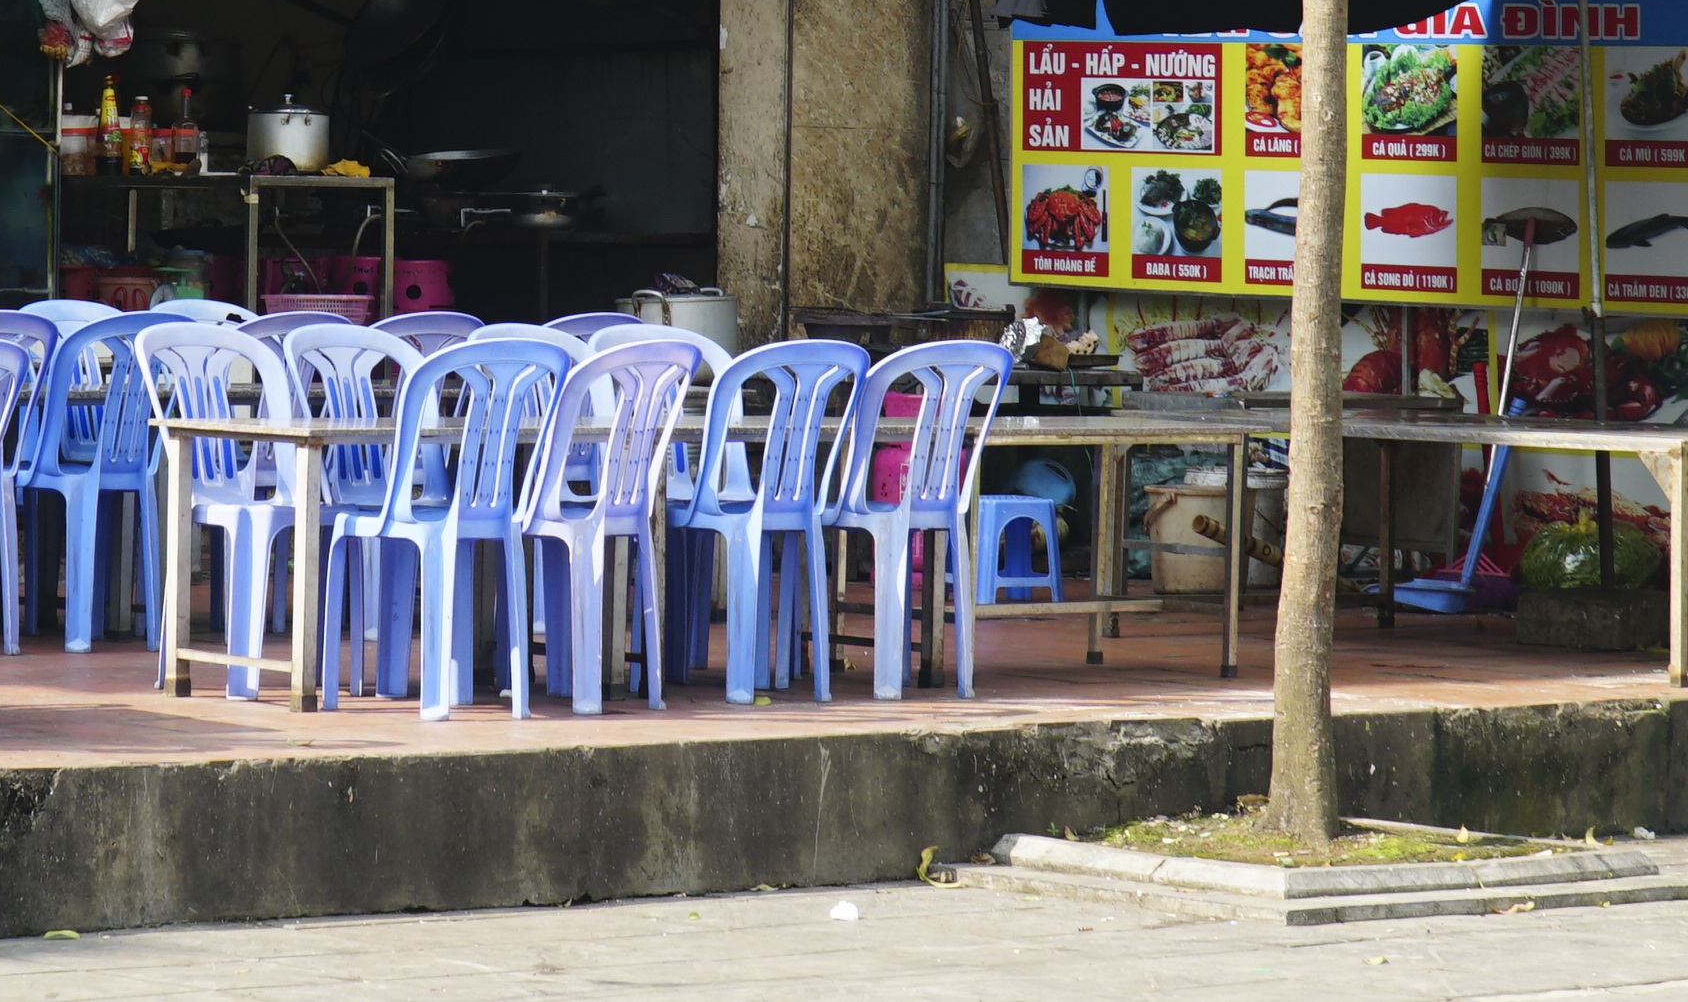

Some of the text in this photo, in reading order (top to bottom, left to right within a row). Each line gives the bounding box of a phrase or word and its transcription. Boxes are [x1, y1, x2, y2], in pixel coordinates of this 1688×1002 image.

[1029, 43, 1216, 78] LẨU HẤP NƯỚNG
[1029, 81, 1061, 111] HẢI
[1028, 117, 1069, 148] SẢN
[1253, 135, 1292, 153] CÁ LĂNG
[1372, 139, 1439, 157] CÁ QUẢ 299K
[1485, 142, 1496, 157] CÁ
[1498, 142, 1519, 158] CHÉP
[1549, 147, 1571, 160] 399K
[1619, 145, 1686, 162] CÁ 599K
[1034, 255, 1052, 272] TÔM
[1054, 254, 1082, 273] HOÀNG
[1146, 262, 1202, 278] BABA 550K
[1248, 265, 1276, 282] TRẠCH
[1364, 269, 1448, 288] CÁ SONG ĐỎ 1190K
[1490, 276, 1502, 291] CÁ
[1534, 281, 1564, 294] 1090K
[1608, 281, 1620, 296] CÁ
[1649, 284, 1668, 298] ĐEN
[1675, 287, 1688, 299] 33
